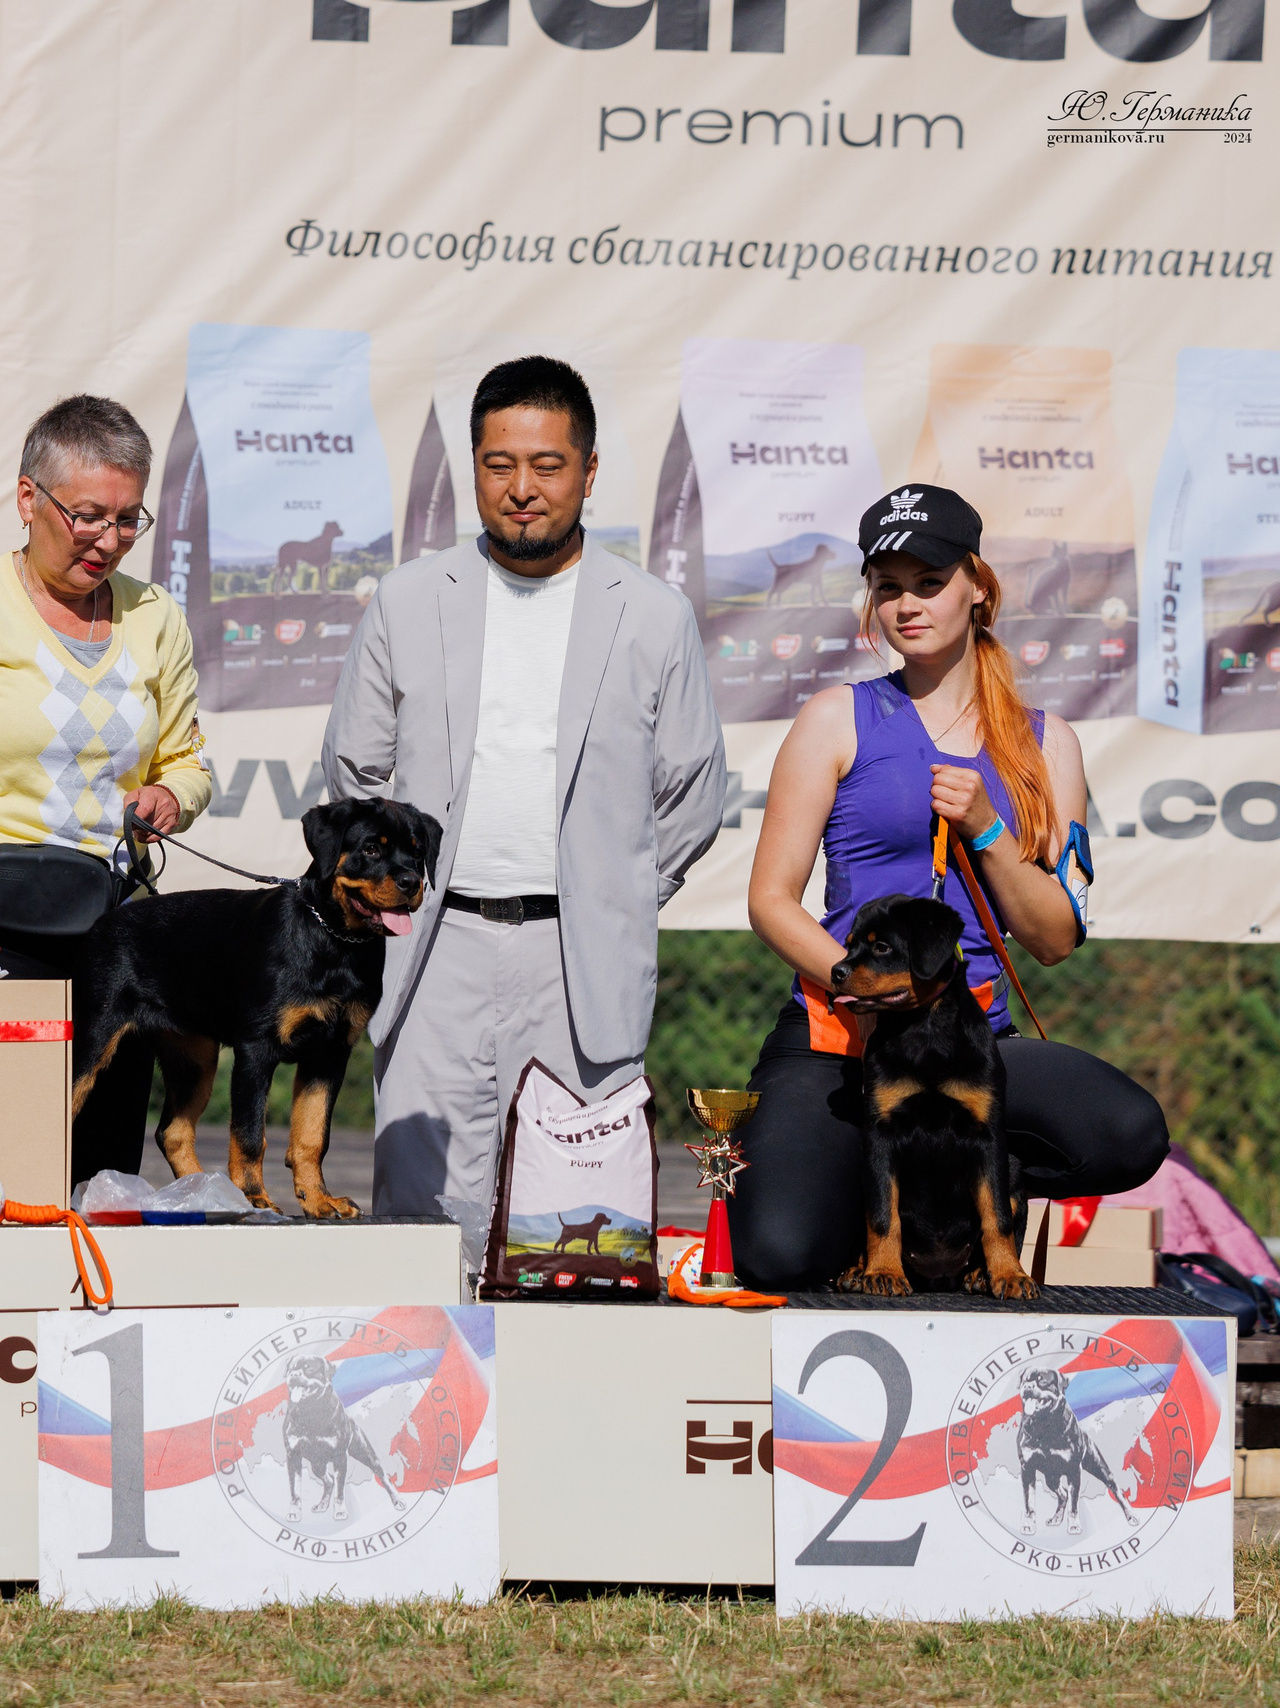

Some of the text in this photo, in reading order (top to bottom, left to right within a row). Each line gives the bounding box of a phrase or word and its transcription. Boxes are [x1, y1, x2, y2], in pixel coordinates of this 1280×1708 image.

[599, 99, 966, 152] premium
[284, 218, 1275, 280] Философия сбалансированного питания
[235, 429, 354, 453] Hanta
[730, 442, 848, 465] Hanta
[979, 447, 1094, 469] Hanta
[879, 509, 928, 526] adidas
[570, 1160, 604, 1168] PUPPY
[215, 1321, 460, 1499] РОТВЕЙЛЕР КЛУБ РОССИИ
[950, 1333, 1192, 1513] РОТВЕЙЛЕР КЛУБ РОССИИ
[71, 1323, 180, 1560] 1
[795, 1329, 927, 1567] 2
[276, 1521, 410, 1558] РКФ-НКПР
[1010, 1536, 1143, 1574] РКФ-НКПР
